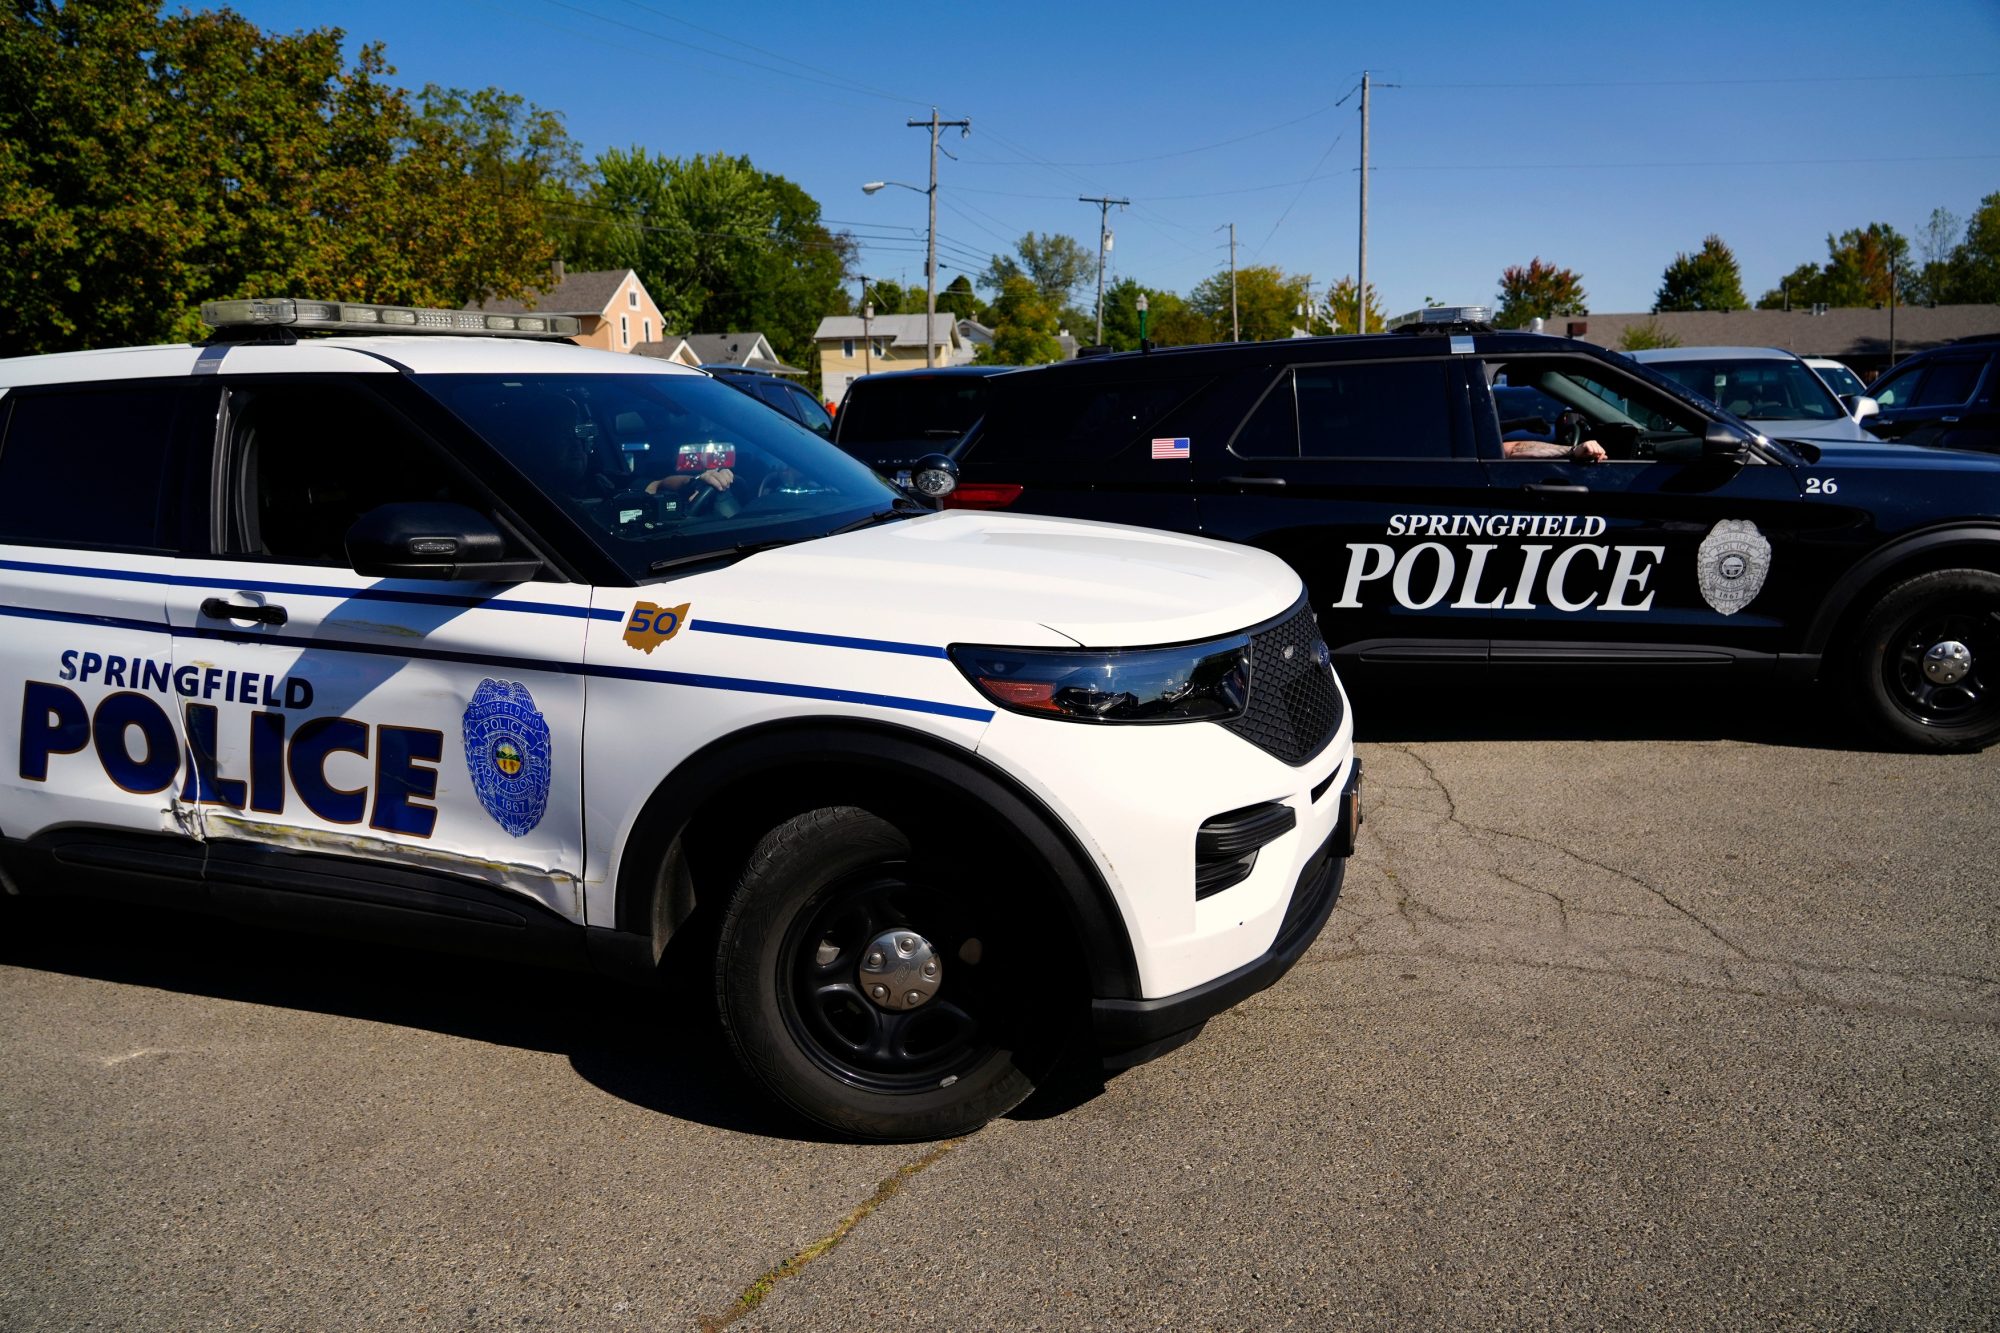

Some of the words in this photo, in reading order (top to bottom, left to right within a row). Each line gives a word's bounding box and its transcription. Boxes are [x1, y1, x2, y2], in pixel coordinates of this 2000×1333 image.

[1805, 477, 1838, 495] 26
[1386, 514, 1607, 538] SPRINGFIELD
[1716, 542, 1752, 553] POLICE
[1332, 541, 1666, 612] POLICE
[1719, 591, 1739, 600] 1867
[628, 608, 678, 635] 50
[59, 649, 314, 711] SPRINGFIELD
[470, 702, 521, 718] SPRINGFIELD
[521, 711, 540, 729] OHIO
[482, 717, 528, 739] POLICE
[18, 679, 445, 840] POLICE
[484, 766, 535, 792] DIVISION
[500, 798, 525, 813] 1867
